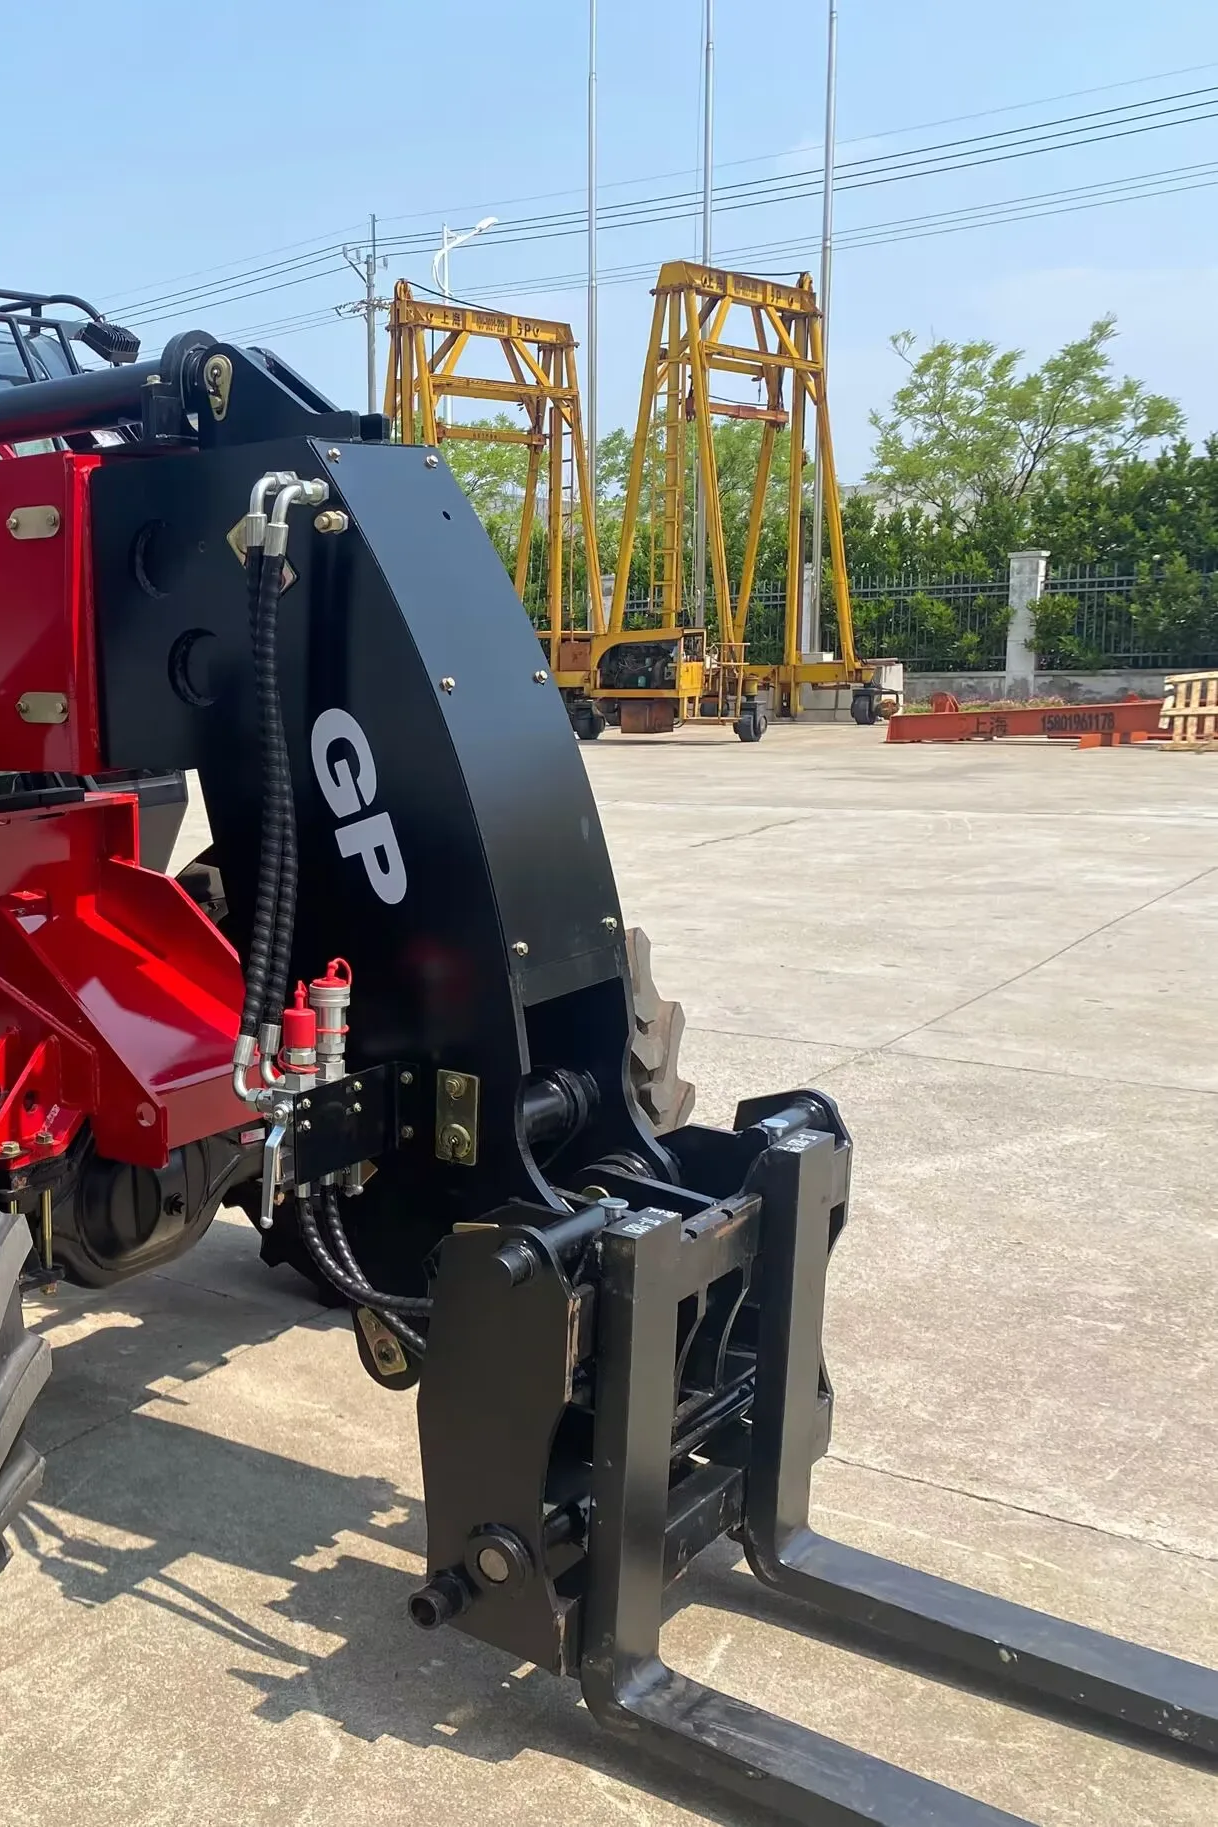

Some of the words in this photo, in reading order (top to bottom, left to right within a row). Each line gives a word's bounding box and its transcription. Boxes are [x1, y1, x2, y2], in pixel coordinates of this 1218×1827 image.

[441, 310, 461, 327] 上海
[971, 716, 1007, 735] 上海
[1041, 712, 1115, 732] 15801961178
[311, 708, 407, 904] GP
